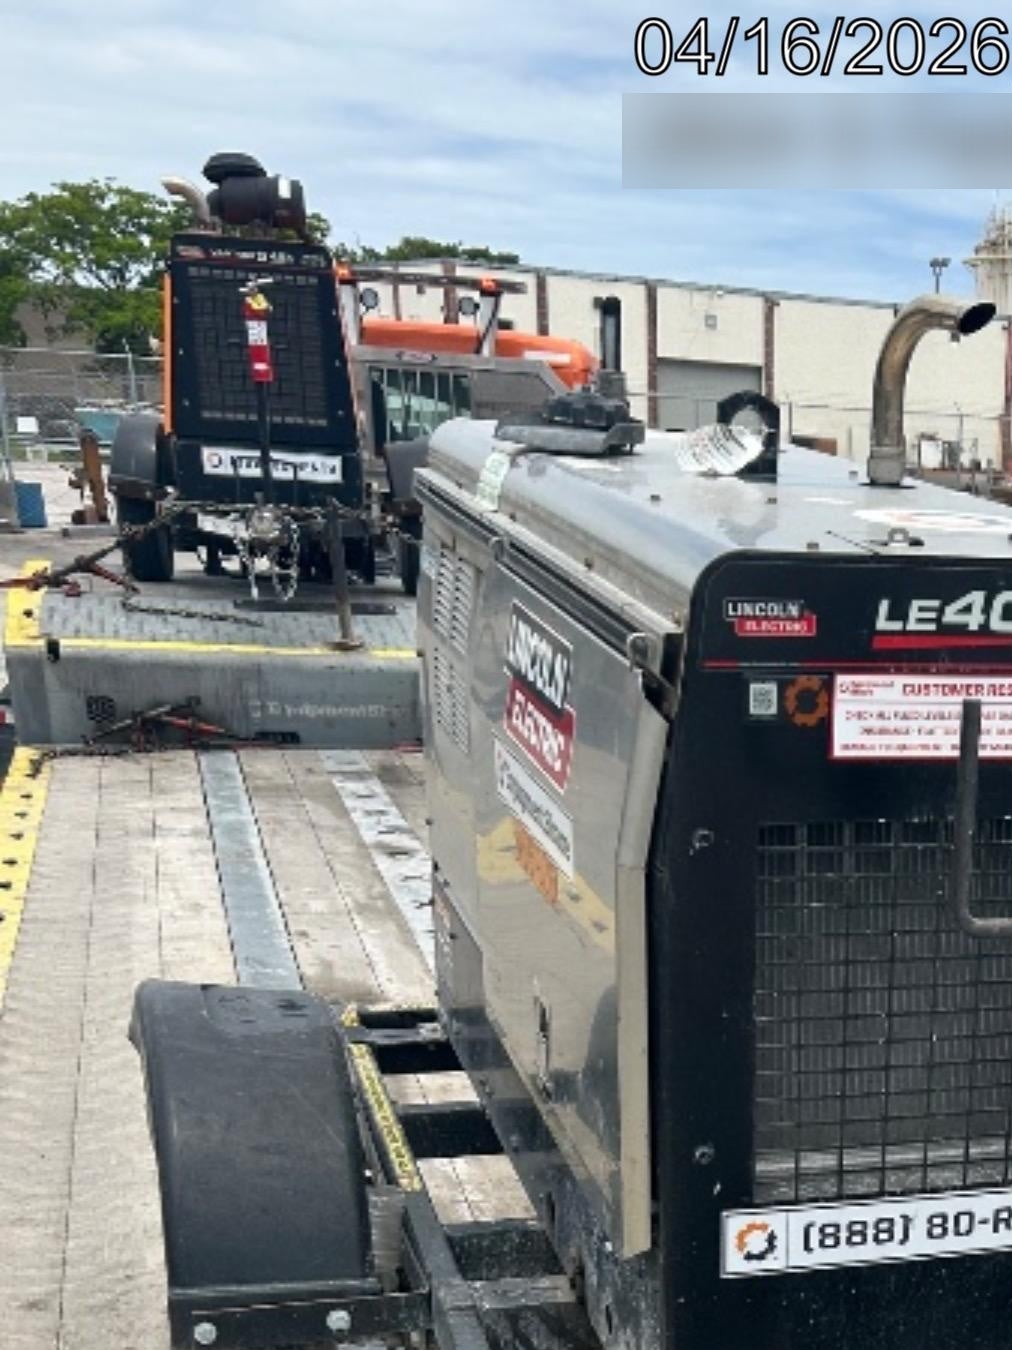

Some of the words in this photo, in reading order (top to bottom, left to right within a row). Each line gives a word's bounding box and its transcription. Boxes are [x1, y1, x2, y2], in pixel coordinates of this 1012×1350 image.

[727, 601, 799, 618] LINCOLN
[902, 683, 984, 697] CUSTOMER
[802, 1212, 913, 1254] (888)
